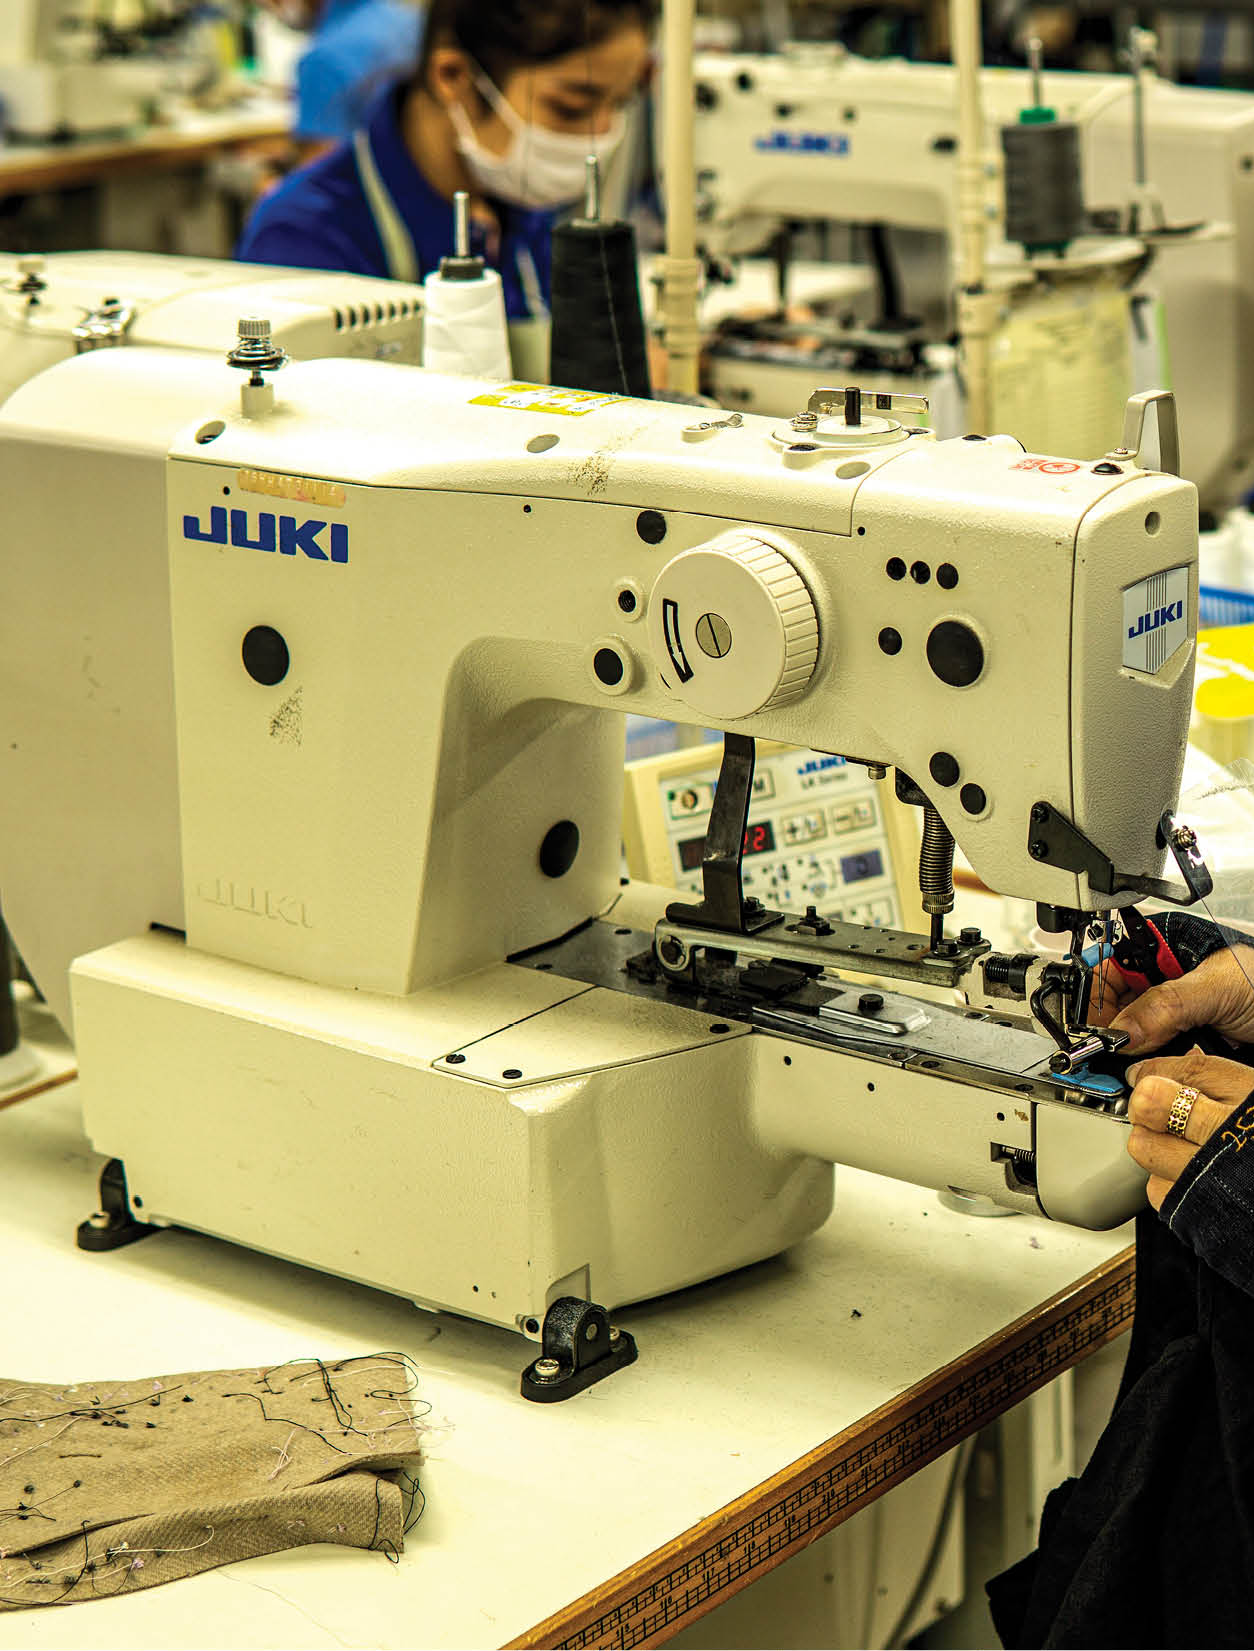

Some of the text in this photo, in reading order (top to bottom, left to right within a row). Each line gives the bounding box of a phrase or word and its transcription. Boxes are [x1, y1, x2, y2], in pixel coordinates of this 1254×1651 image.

[183, 506, 349, 564] JUKI
[1128, 600, 1183, 639] JUKI
[196, 878, 313, 928] JUKI
